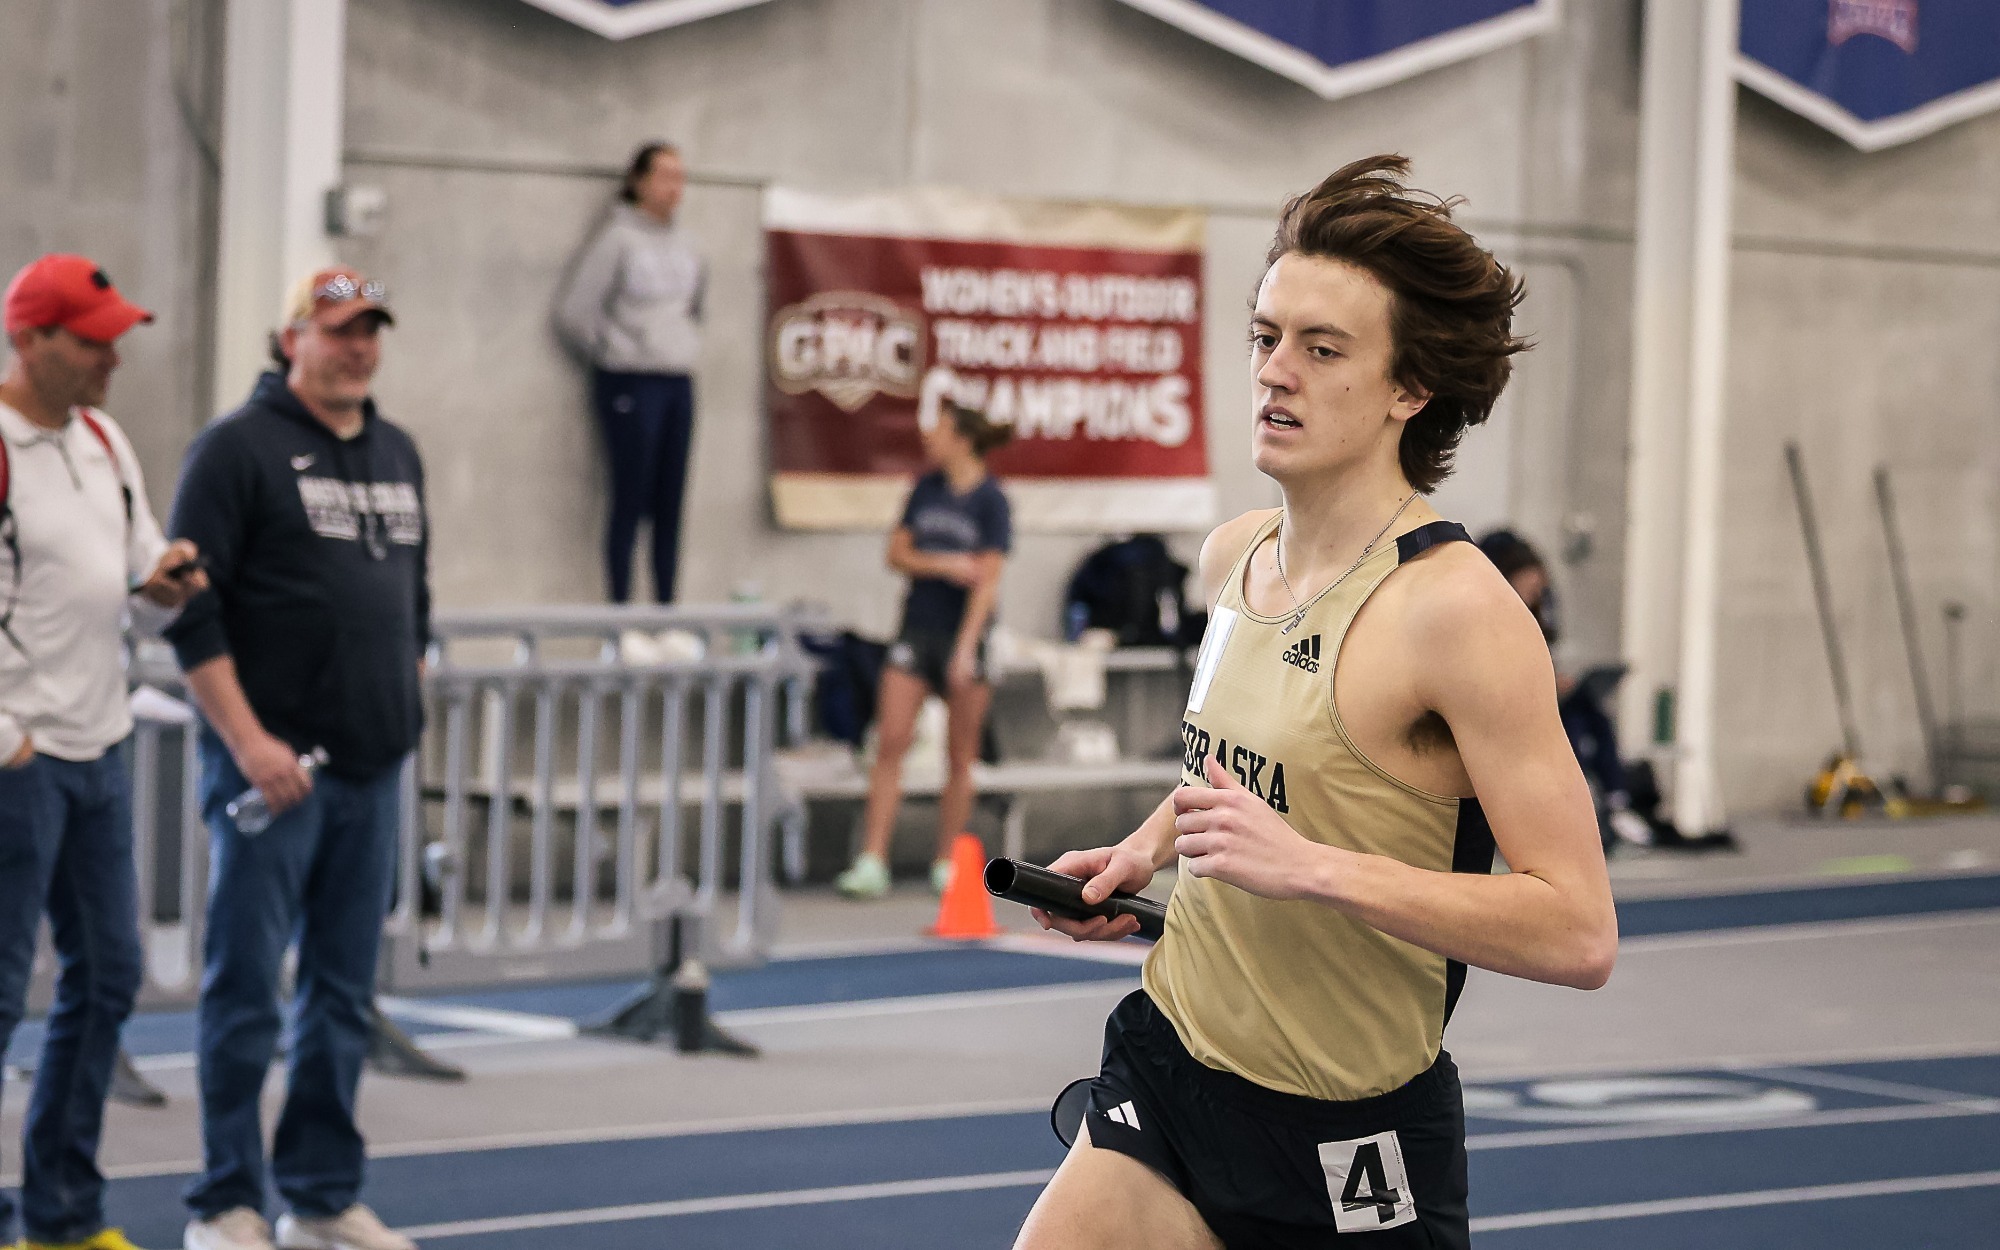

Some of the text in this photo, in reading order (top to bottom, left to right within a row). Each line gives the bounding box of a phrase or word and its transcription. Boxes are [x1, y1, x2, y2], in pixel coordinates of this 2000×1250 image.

[921, 266, 1058, 318] WOMEN'S
[933, 319, 1184, 374] TRACK AND FIELD
[1282, 650, 1320, 674] adidas
[1340, 1141, 1401, 1225] 4
